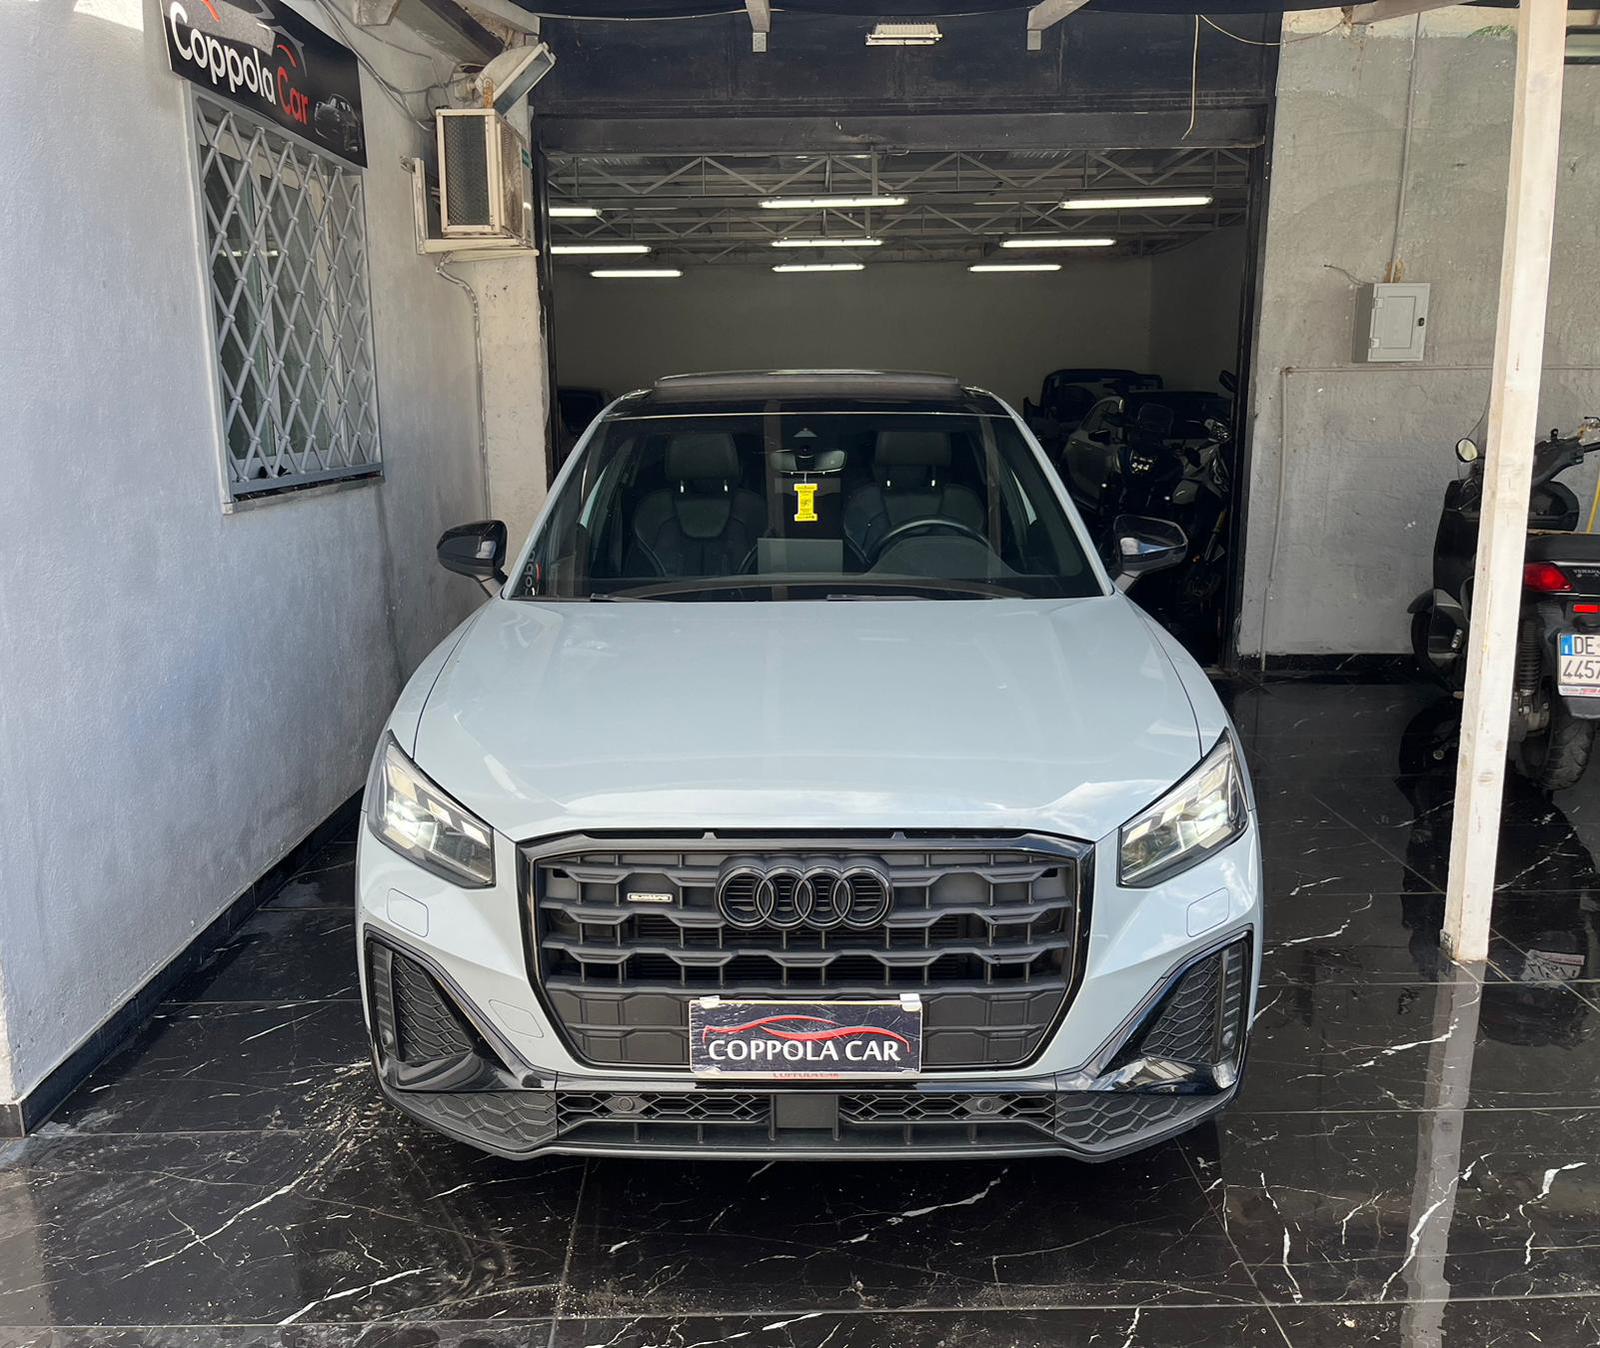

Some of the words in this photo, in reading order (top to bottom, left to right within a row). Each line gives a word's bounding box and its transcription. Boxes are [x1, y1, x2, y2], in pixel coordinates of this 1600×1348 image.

[170, 1, 276, 105] Coppola
[277, 66, 310, 125] Car
[1574, 636, 1595, 655] DE
[708, 1040, 839, 1061] COPPOLA
[845, 1040, 901, 1061] CAR
